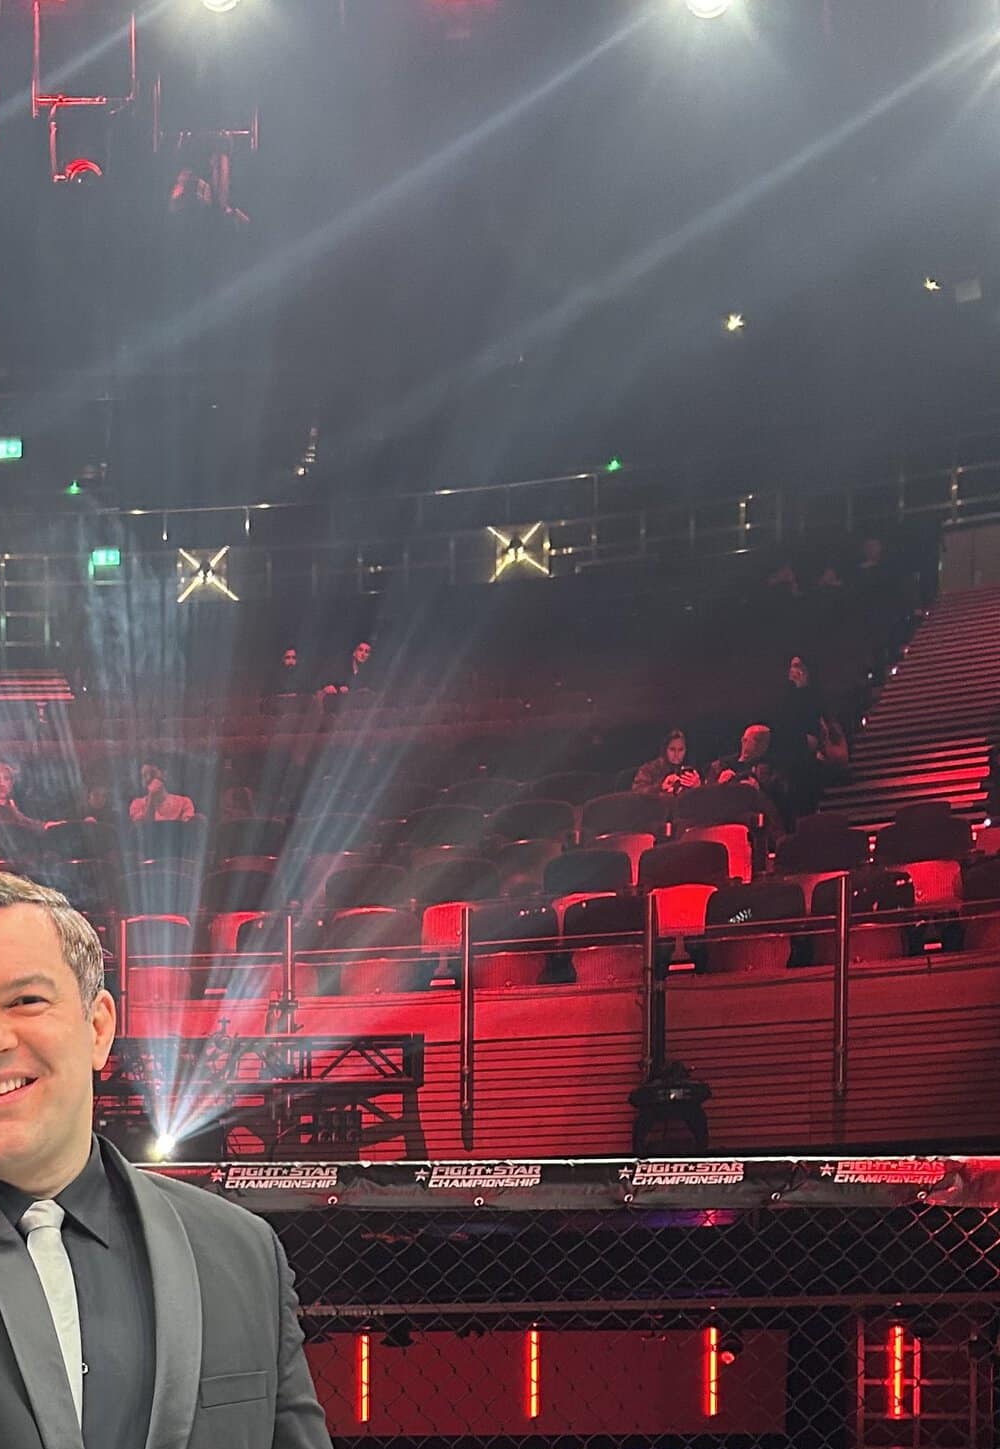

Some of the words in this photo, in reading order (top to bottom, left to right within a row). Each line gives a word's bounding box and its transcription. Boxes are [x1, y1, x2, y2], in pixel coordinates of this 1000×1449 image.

[225, 1178, 337, 1189] CHAMPIONSHIP
[428, 1177, 541, 1188] CHAMPIONSHIP
[632, 1174, 744, 1185] CHAMPIONSHIP
[834, 1173, 945, 1184] CHAMPIONSHIP
